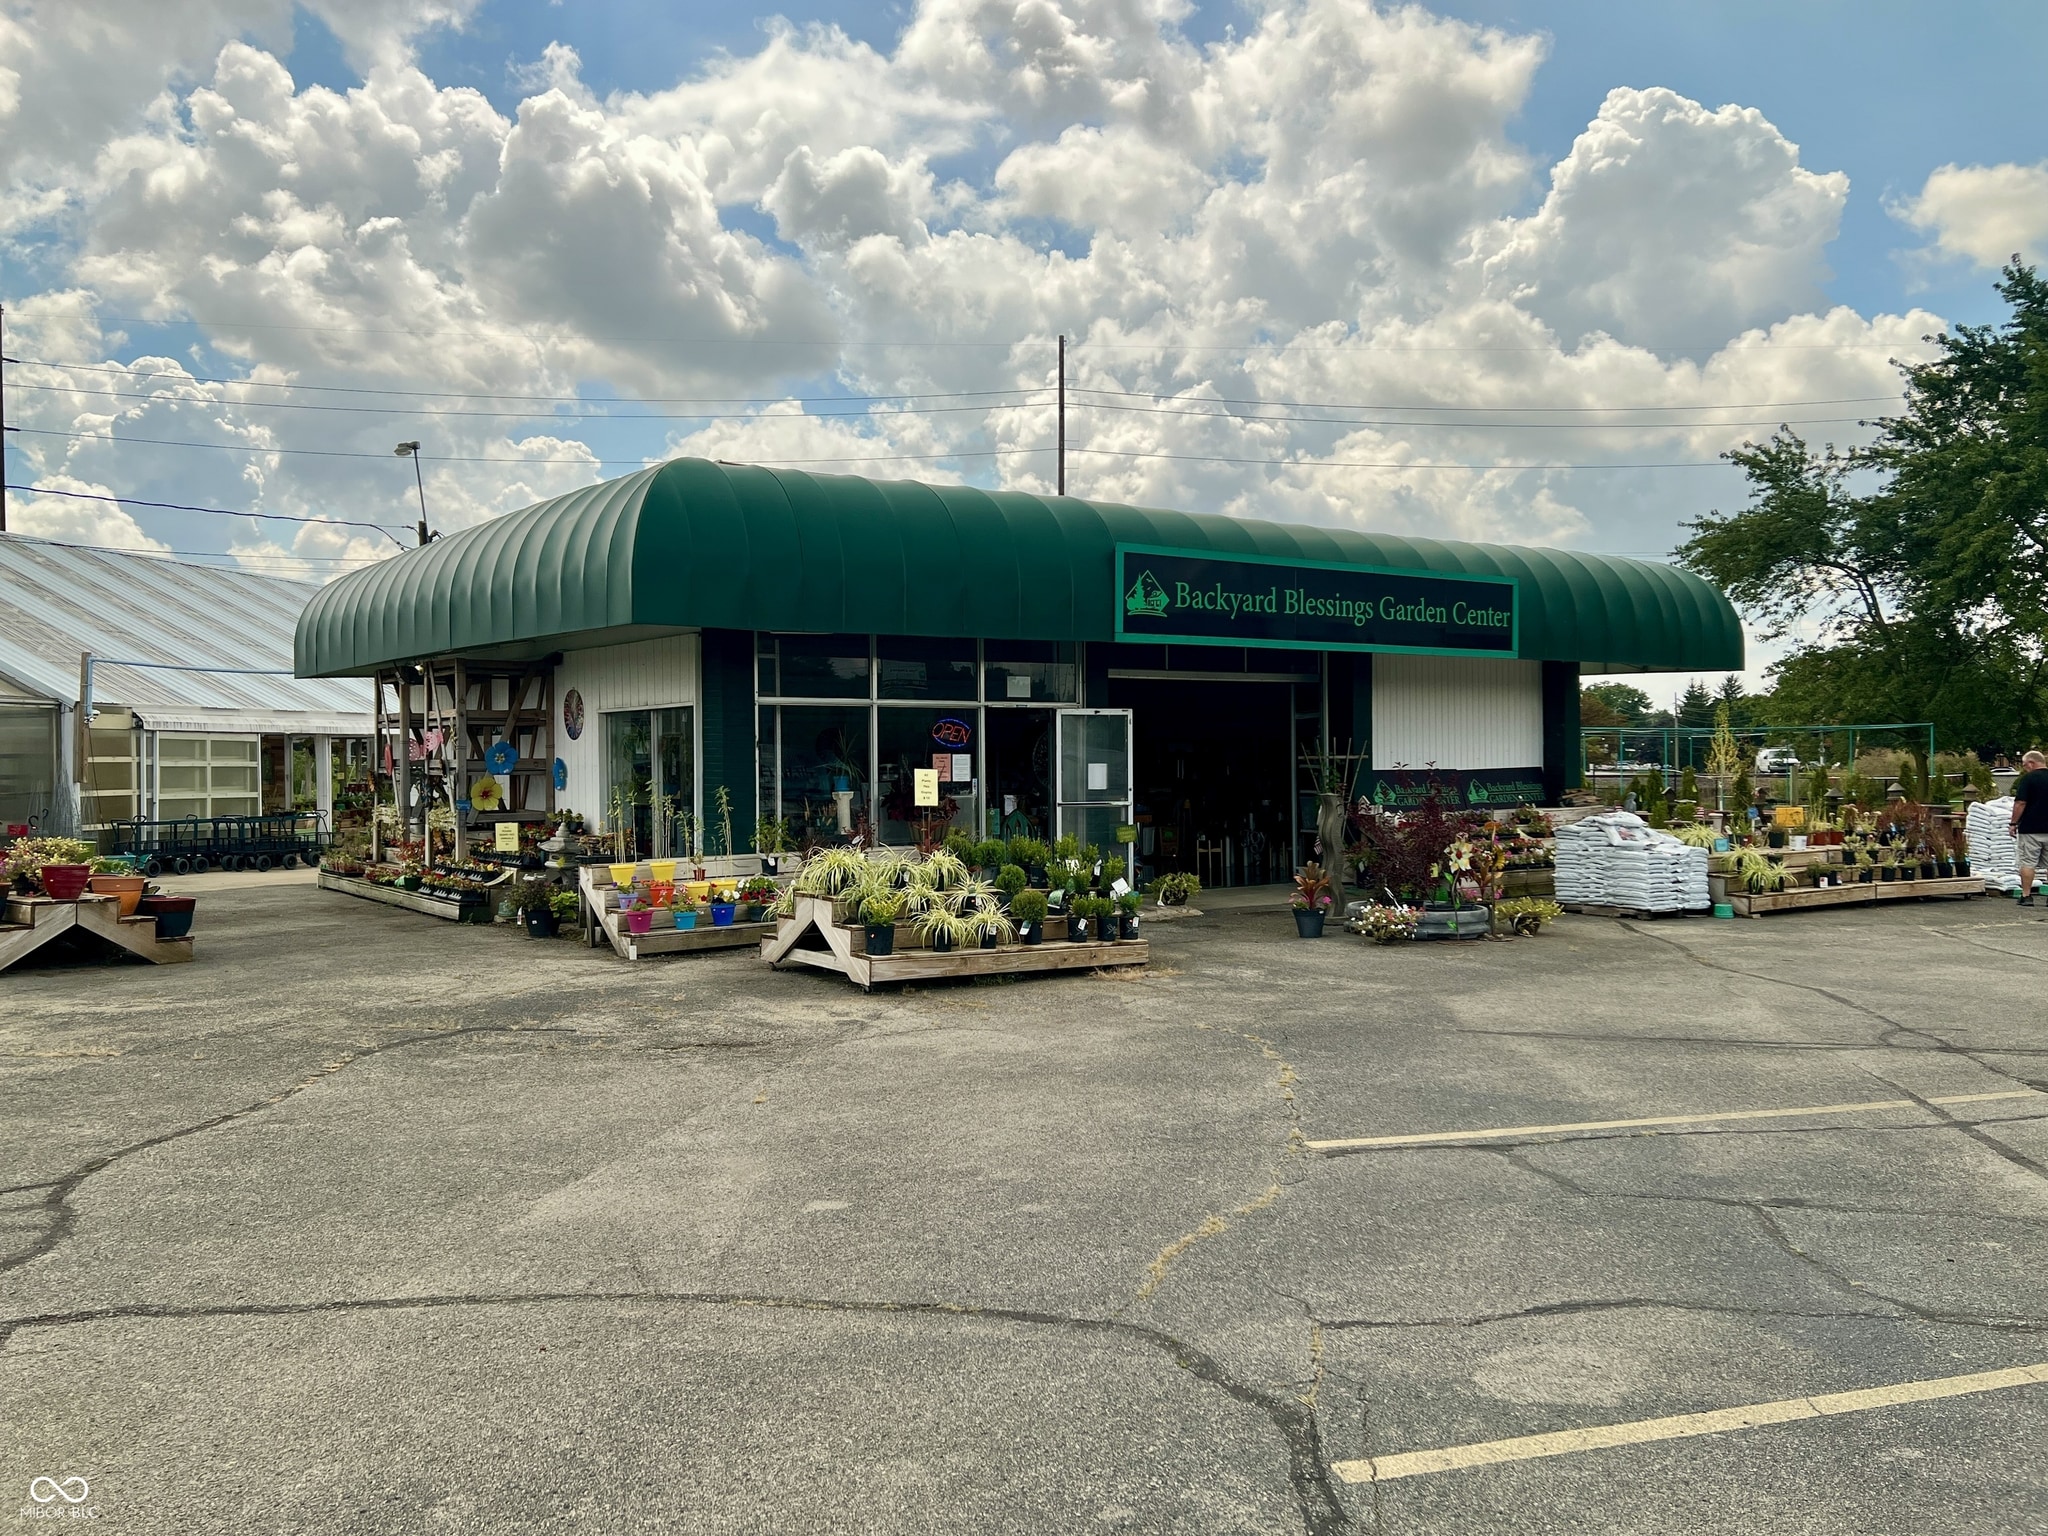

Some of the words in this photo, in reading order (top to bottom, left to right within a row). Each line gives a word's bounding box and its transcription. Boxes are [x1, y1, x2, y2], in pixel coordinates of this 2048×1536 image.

[1175, 582, 1277, 620] Backyard
[1284, 589, 1374, 627] Blessings
[1379, 596, 1448, 623] Garden
[1452, 601, 1511, 627] Center
[932, 722, 971, 743] OPEN
[1397, 796, 1427, 806] GARD
